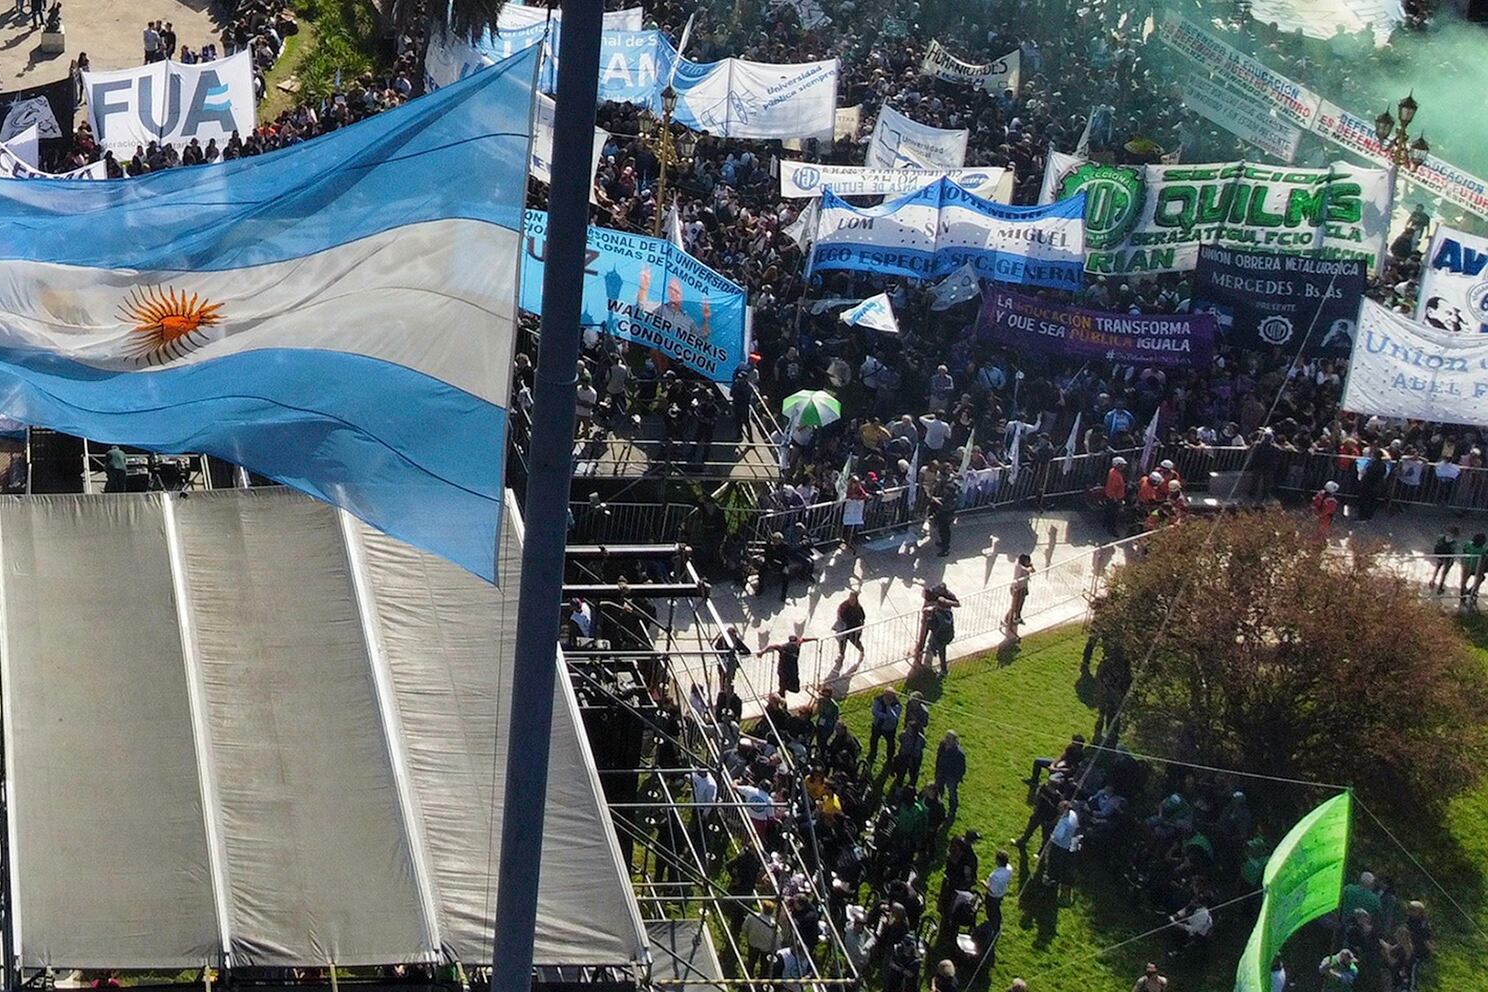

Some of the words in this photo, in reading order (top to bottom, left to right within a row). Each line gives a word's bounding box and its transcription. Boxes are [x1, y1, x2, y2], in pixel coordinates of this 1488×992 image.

[766, 65, 822, 95] Universidad
[926, 47, 1009, 77] HUMANIDADES
[92, 70, 244, 141] FUA
[1268, 88, 1312, 119] FUTURO
[596, 241, 644, 260] LOMAS
[647, 254, 664, 267] DE
[664, 262, 710, 296] ZAMORA
[639, 240, 656, 253] DE
[660, 244, 674, 259] LA
[1235, 254, 1282, 271] OBRERA
[1285, 258, 1360, 275] METALURGICA
[1211, 271, 1294, 297] MERCEDES
[607, 298, 673, 334] WALTER
[675, 326, 728, 362] MERKIS
[995, 310, 1005, 323] Y
[1007, 314, 1035, 331] QUE
[1038, 321, 1066, 338] SEA
[1136, 336, 1191, 353] IGUALA
[997, 295, 1013, 310] LA
[1094, 318, 1191, 335] TRANSFORMA
[617, 320, 717, 374] CONDUCCION
[1365, 330, 1470, 373] Union
